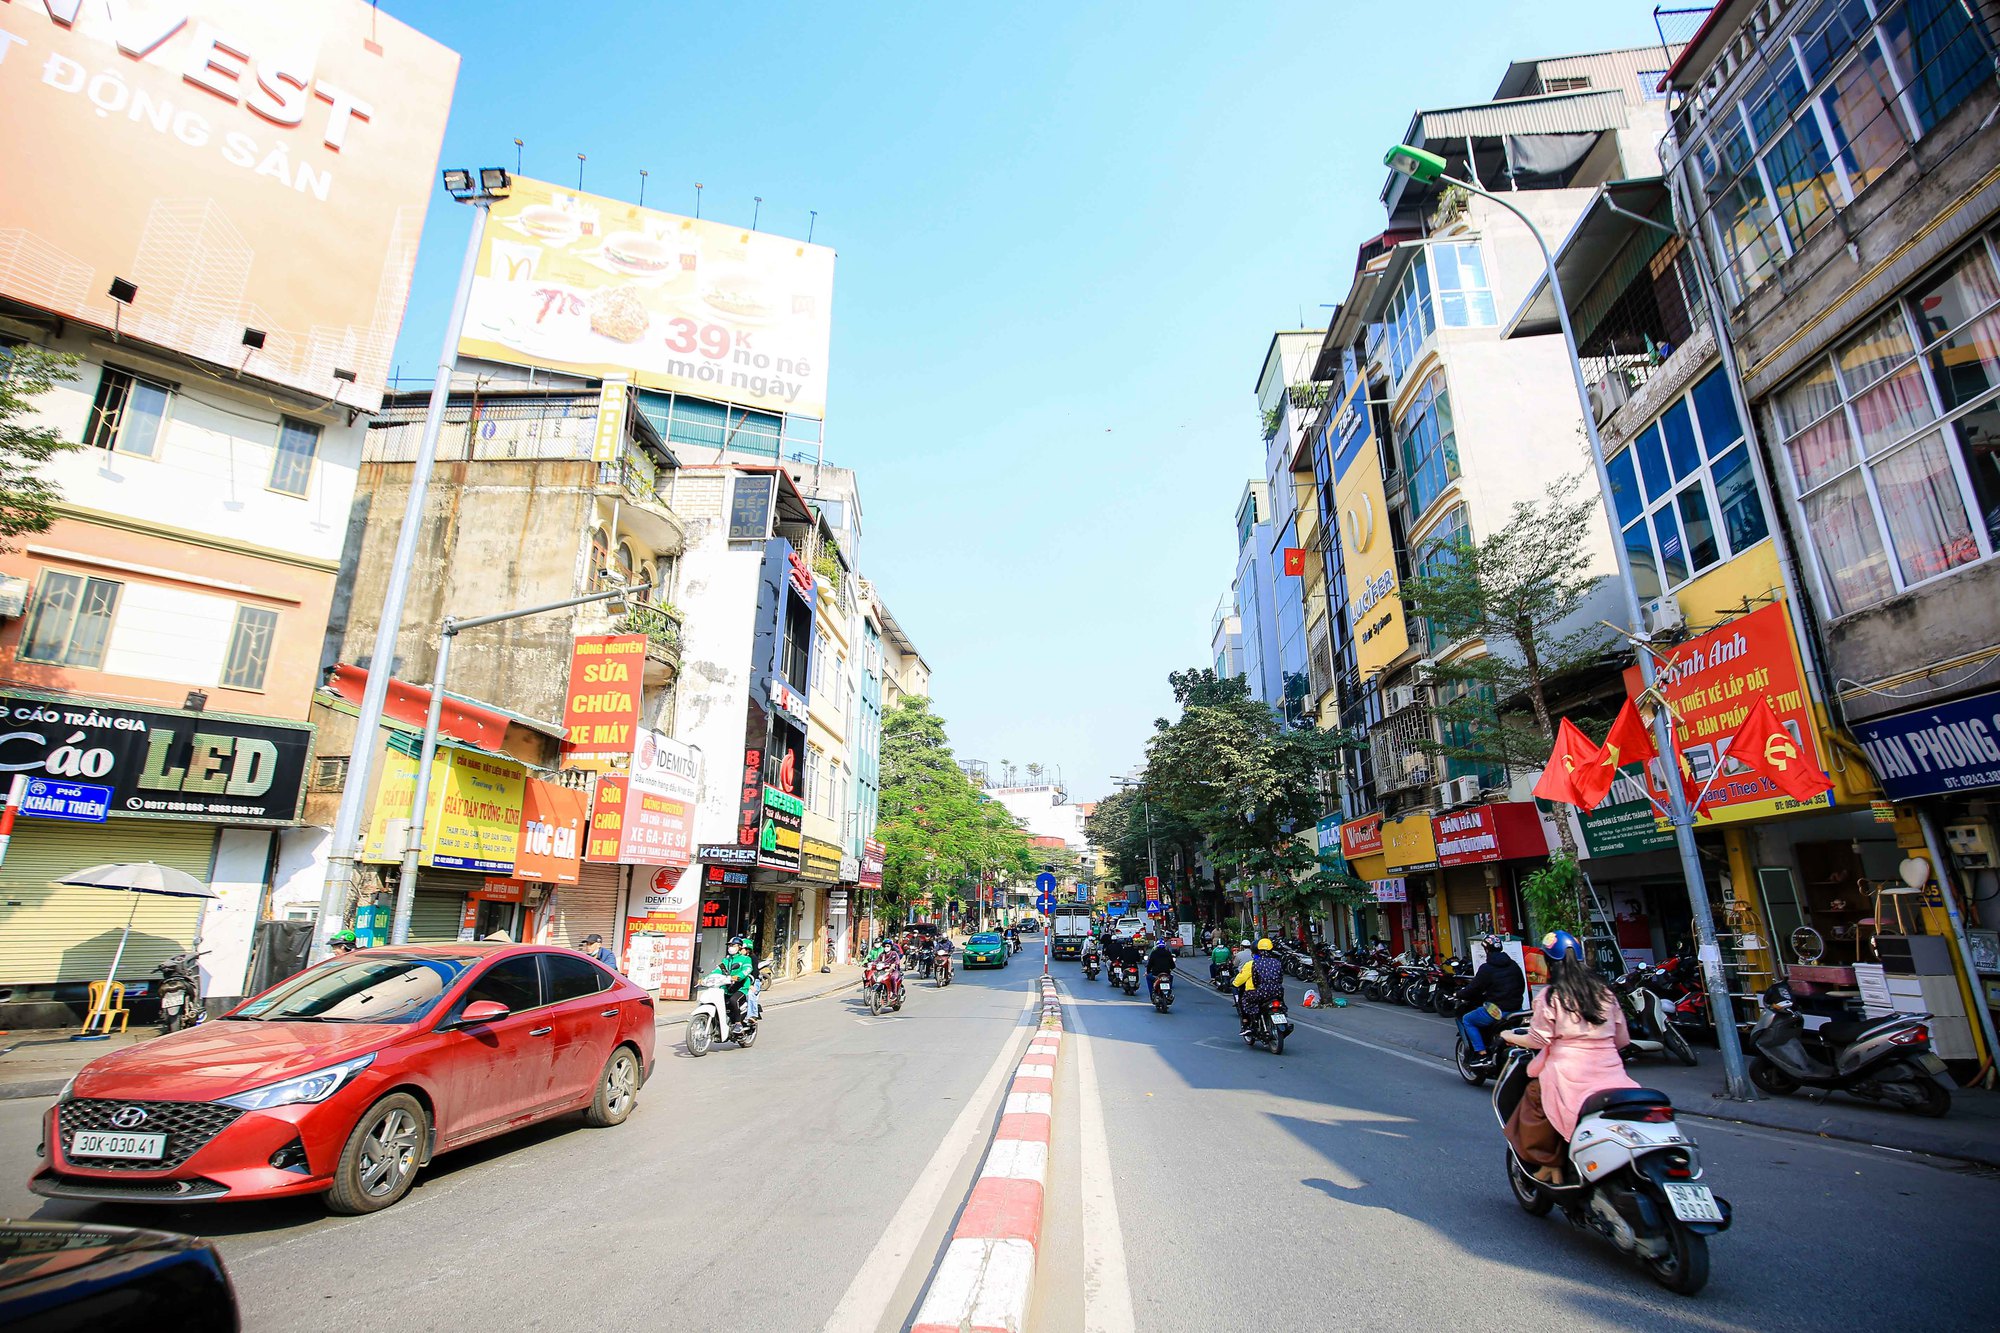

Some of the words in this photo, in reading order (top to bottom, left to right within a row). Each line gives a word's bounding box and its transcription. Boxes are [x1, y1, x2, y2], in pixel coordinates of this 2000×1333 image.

[41, 52, 213, 147] ĐỘNG
[221, 130, 332, 201] SẢN
[733, 348, 770, 369] no
[776, 357, 811, 377] nê
[667, 359, 724, 384] mỗi
[731, 374, 802, 403] ngày
[735, 494, 768, 509] BẾP
[739, 509, 761, 523] TỪ
[731, 523, 765, 537] ĐỨC
[576, 642, 603, 656] DŨNG
[1709, 632, 1748, 668] Anh
[583, 658, 628, 682] SỬA
[1680, 686, 1706, 713] THIẾT
[1707, 679, 1723, 704] KẾ
[1723, 672, 1744, 699] LẮP
[1746, 666, 1770, 692] ĐẶT
[572, 691, 632, 713] CHỮA
[14, 706, 60, 723] CÁO
[63, 709, 113, 729] TRẦN
[113, 717, 147, 732] GIA
[1696, 716, 1719, 738] BÀN
[1776, 689, 1802, 714] TIVI
[570, 725, 590, 744] XE
[594, 721, 629, 743] MÁY
[1860, 731, 1918, 781] VĂN
[1905, 715, 2000, 773] PHÒNG
[137, 727, 279, 797] LED
[656, 749, 698, 779] IDEMITSU
[601, 784, 621, 803] SỬA
[1729, 781, 1758, 797] Theo
[25, 795, 66, 813] KHÂM
[67, 800, 105, 817] THIÊN
[445, 791, 463, 816] GIẤY
[594, 811, 621, 830] CHỮA
[525, 814, 553, 857] TÓC
[553, 817, 577, 860] GIẢ
[591, 840, 602, 855] XE
[602, 838, 618, 857] MÁY
[700, 846, 756, 859] KÖCHER
[645, 896, 683, 904] IDEMITSU
[629, 920, 654, 931] DŨNG
[677, 947, 690, 960] SỐ
[80, 1136, 155, 1154] 30K-030.41
